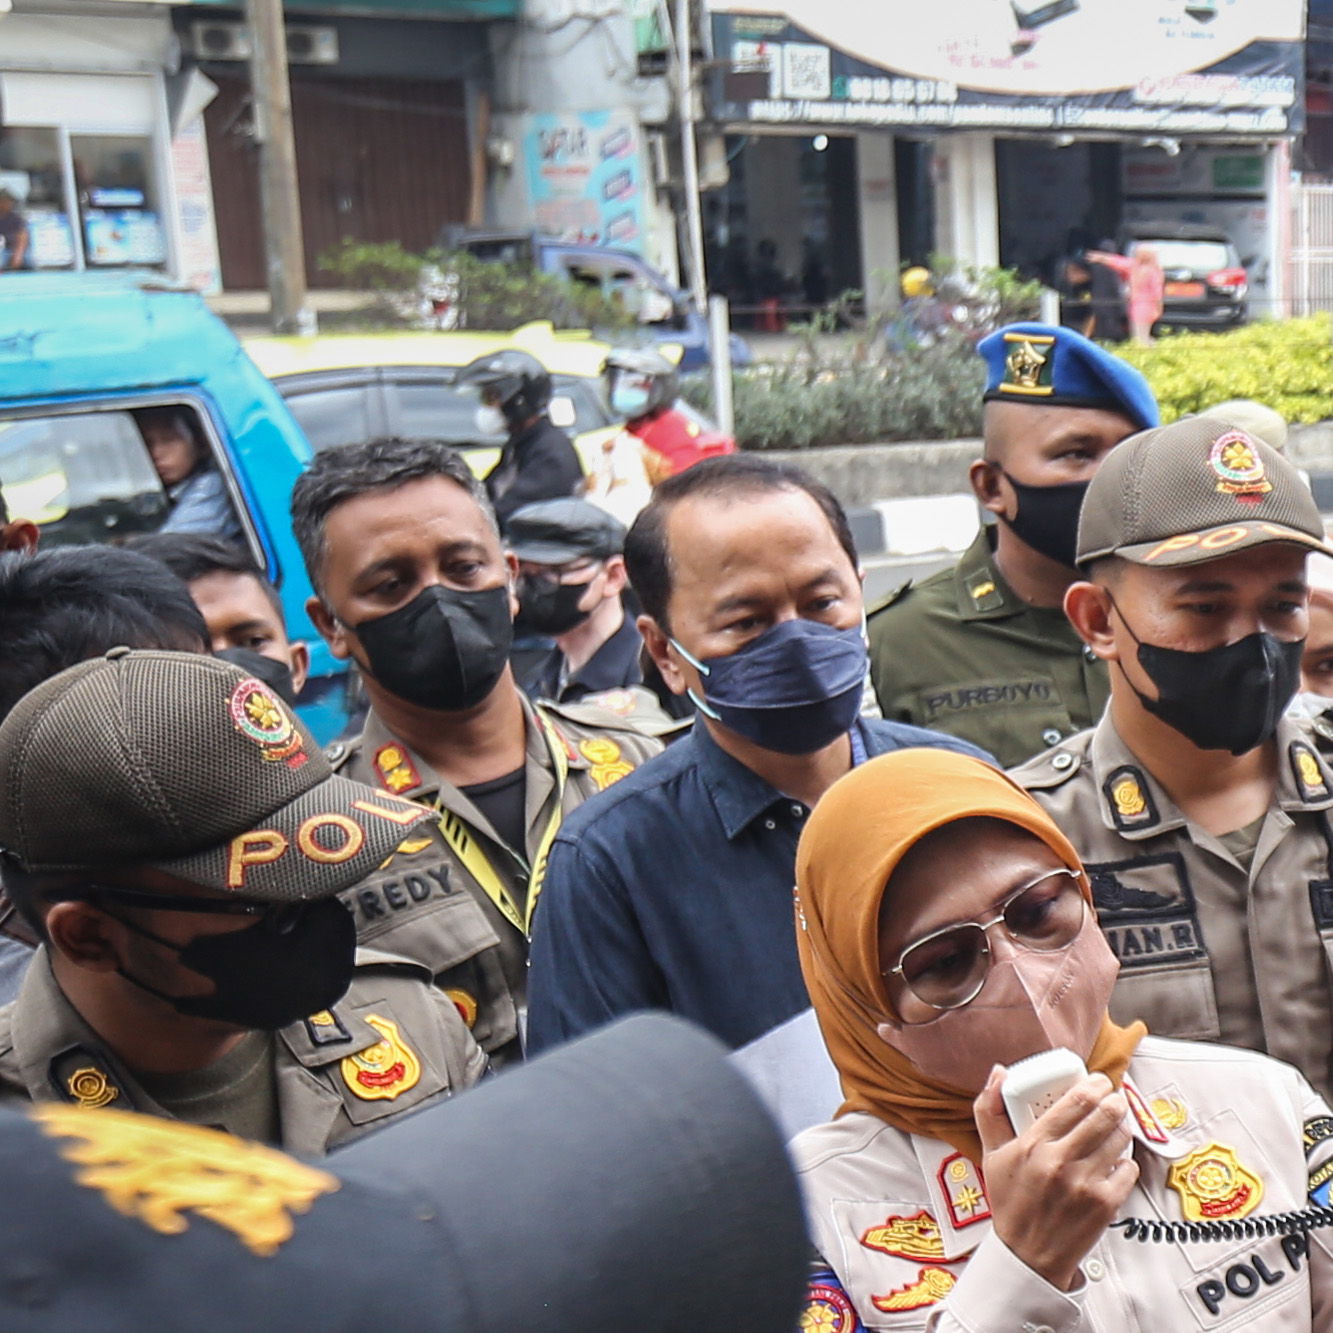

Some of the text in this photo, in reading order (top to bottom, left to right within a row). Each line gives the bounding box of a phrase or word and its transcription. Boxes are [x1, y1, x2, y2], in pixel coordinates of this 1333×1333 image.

[345, 863, 452, 920] REDY
[1197, 1231, 1309, 1316] POL P
